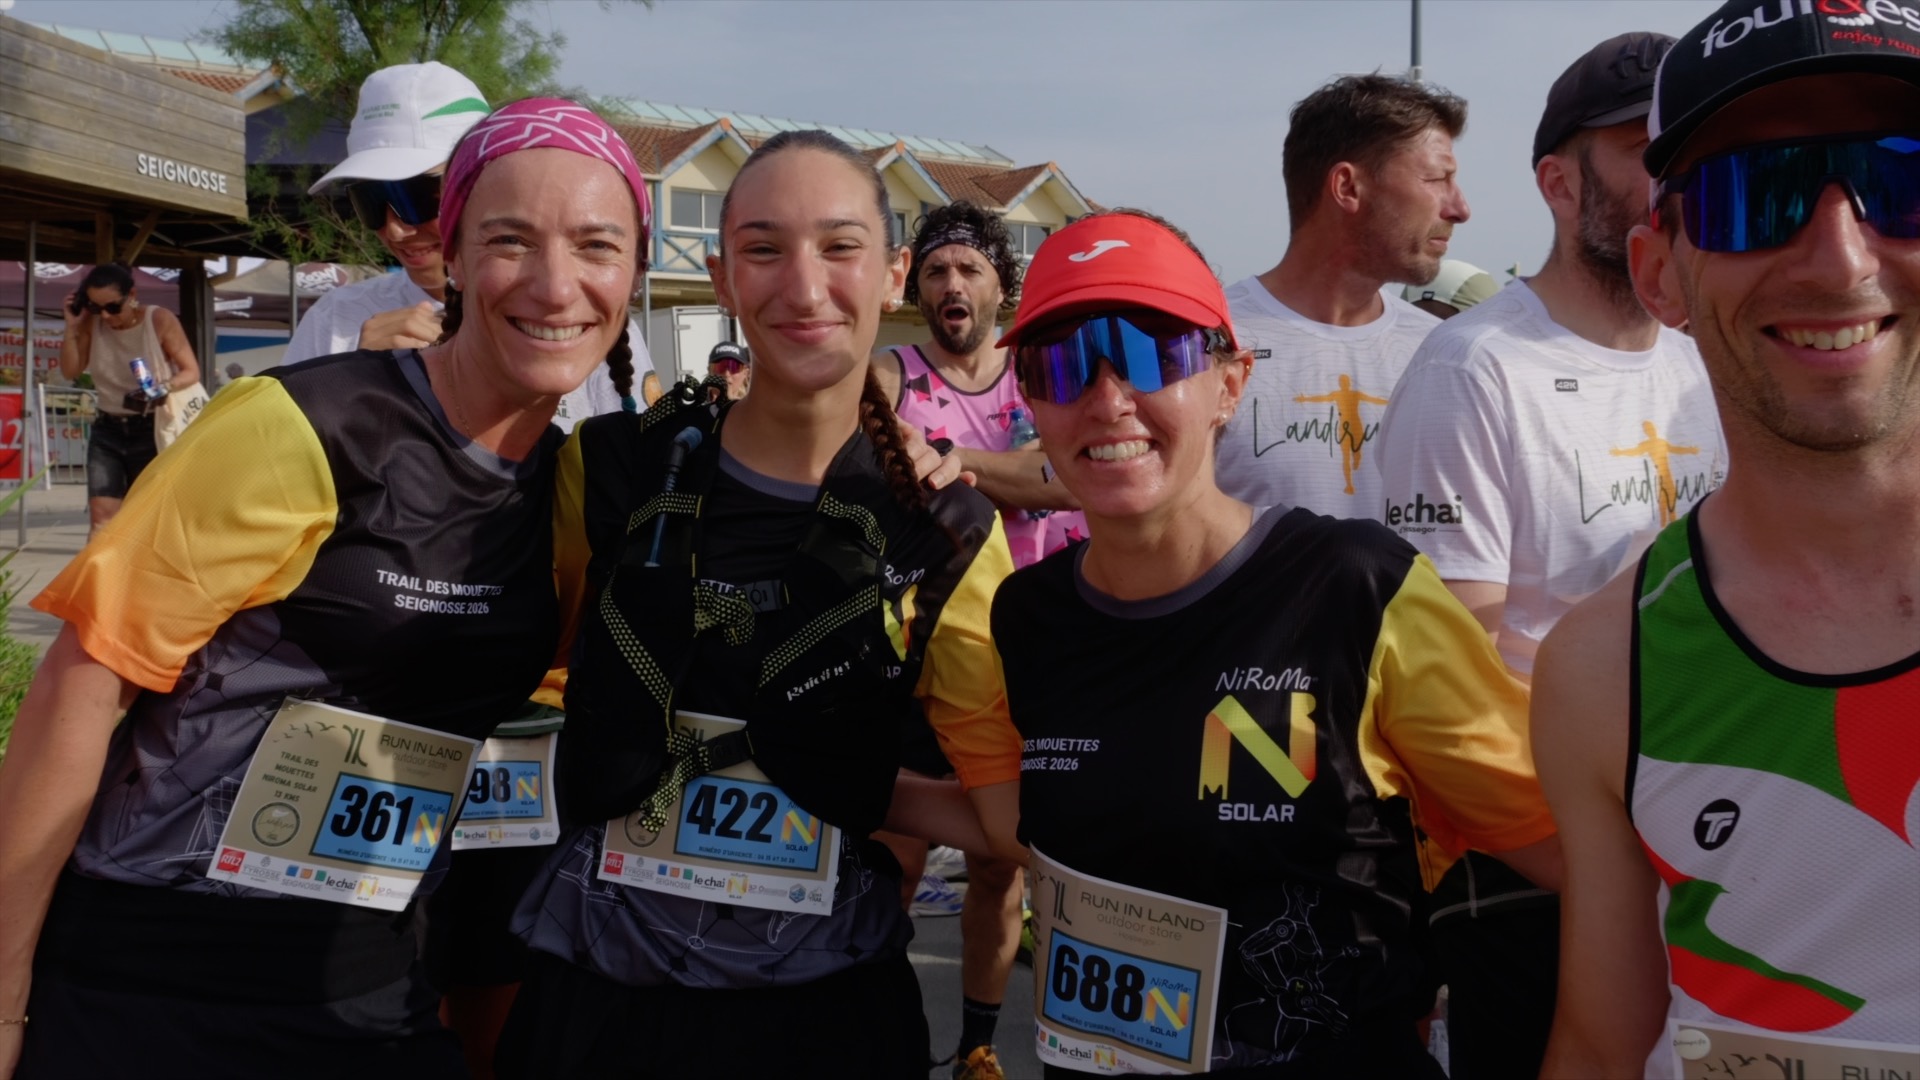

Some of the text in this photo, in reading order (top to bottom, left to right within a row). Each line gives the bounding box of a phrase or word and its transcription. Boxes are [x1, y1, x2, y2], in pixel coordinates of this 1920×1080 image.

[137, 153, 227, 194] SEIGNOSSE
[1557, 381, 1577, 390] 42K
[376, 569, 504, 597] TRAIL DES MOUETTES
[394, 594, 489, 614] SEIGNOSSE 2026
[1215, 667, 1312, 692] NiRoMa
[380, 734, 463, 762] RUN IN LAND
[1036, 737, 1101, 752] MOUETTES
[281, 751, 319, 768] TRAIL DES
[1049, 757, 1079, 771] 2026
[275, 763, 315, 780] MOUETTES
[294, 781, 318, 793] SOLAR
[330, 785, 414, 846] 361
[686, 784, 778, 844] 422
[1218, 803, 1296, 823] SOLAR
[785, 844, 808, 853] SOLAR
[221, 854, 242, 866] RTL2
[325, 876, 334, 887] le
[335, 878, 358, 890] chai
[655, 877, 692, 890] SEIGNOSSE
[694, 874, 703, 885] le
[704, 875, 726, 888] chai
[1080, 891, 1205, 932] RUN IN LAND
[1096, 913, 1183, 941] outdoor store
[1052, 943, 1146, 1023] 688
[1149, 1025, 1178, 1039] SOLAR
[1059, 1043, 1068, 1055] le
[1069, 1045, 1092, 1060] chai
[1841, 1064, 1911, 1080] RUN
